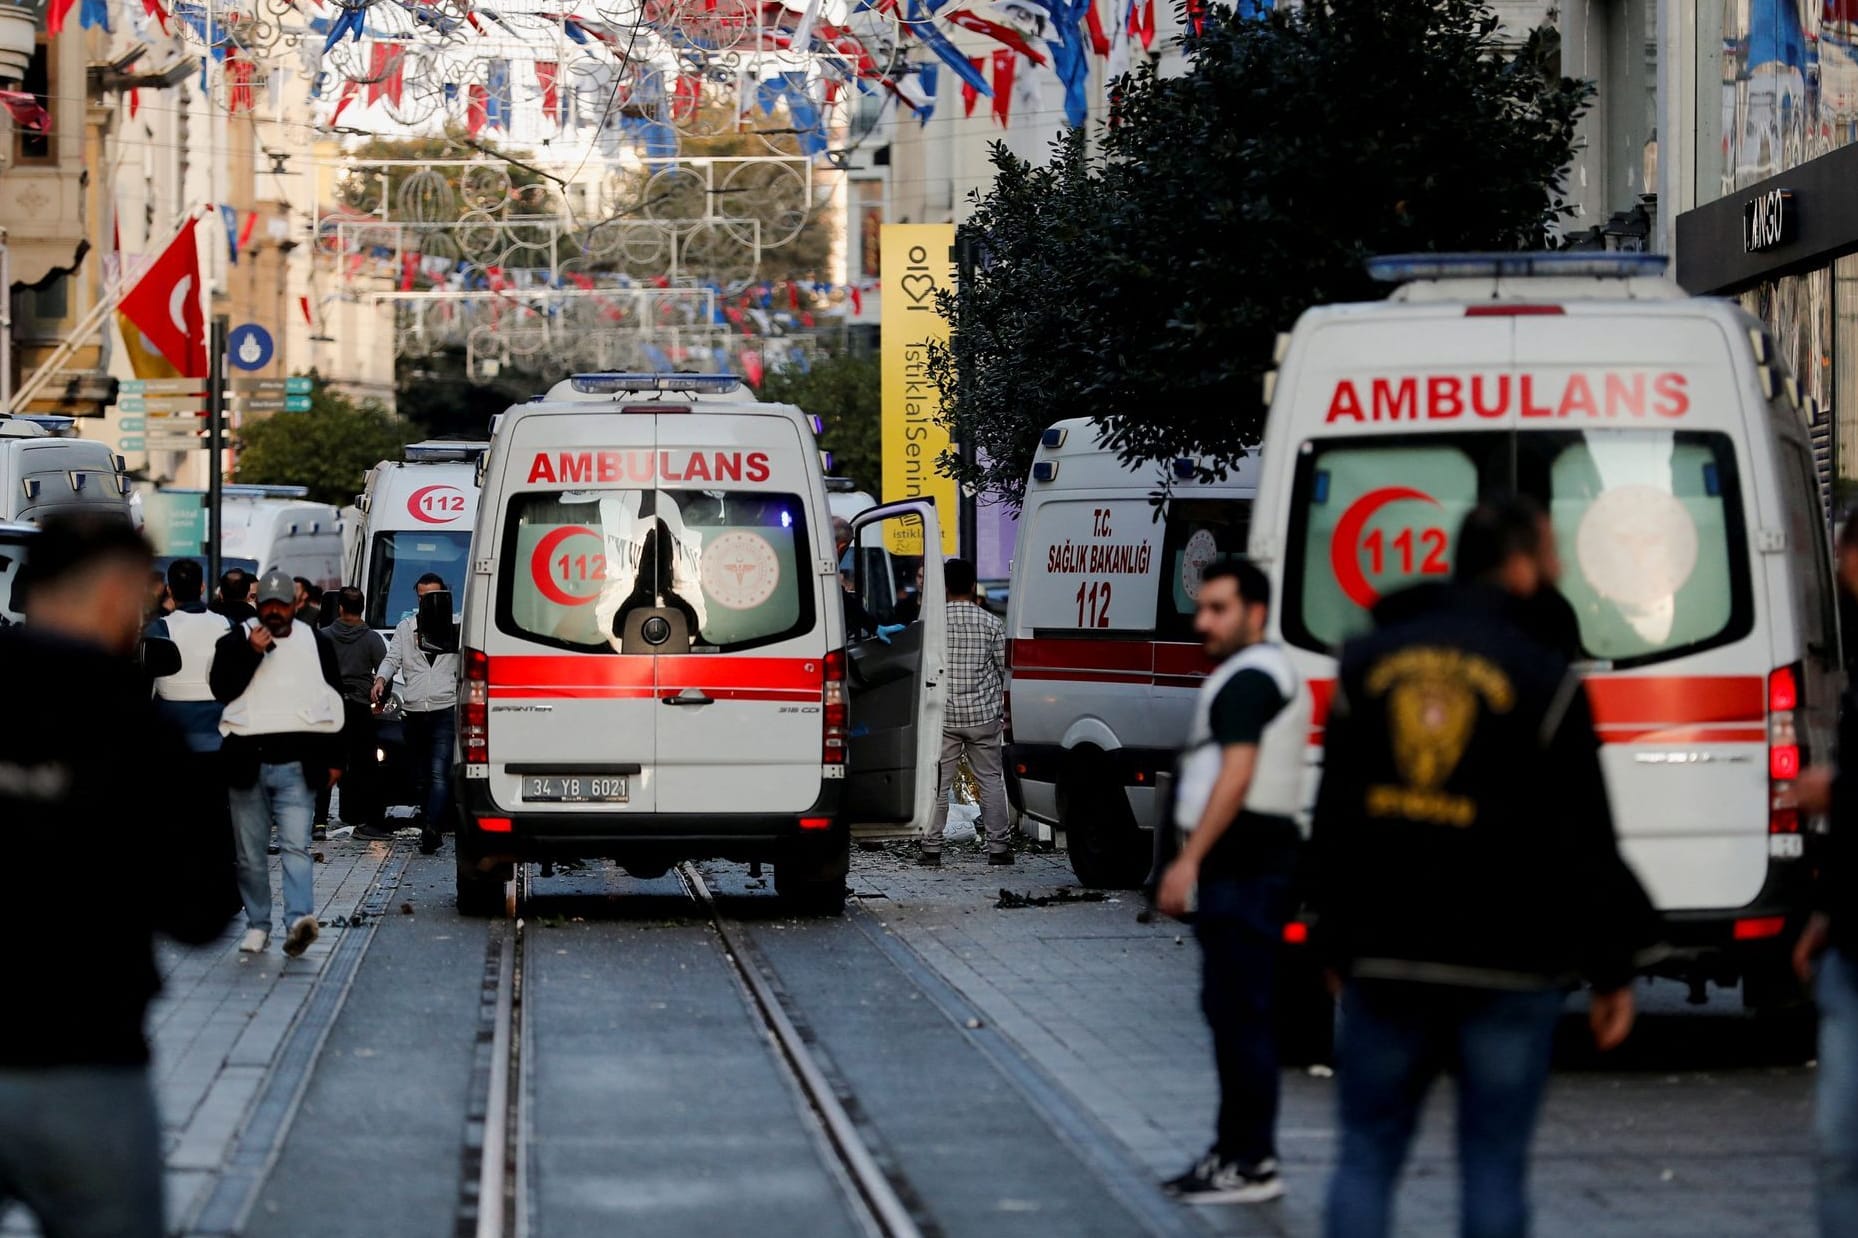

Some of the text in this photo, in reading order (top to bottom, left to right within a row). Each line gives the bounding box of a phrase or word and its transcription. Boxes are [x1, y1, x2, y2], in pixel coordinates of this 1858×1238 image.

[1325, 371, 1691, 424] AMBULANS
[527, 451, 771, 484] AMBULANS
[422, 495, 465, 511] 112
[1093, 508, 1112, 537] T.C.
[1047, 539, 1089, 574] SAĞLIK
[1089, 539, 1152, 574] BAKANLIĞI
[1362, 526, 1451, 575] 112
[557, 553, 607, 582] 112
[1076, 581, 1112, 628] 112
[533, 779, 627, 796] 34 YB 6021
